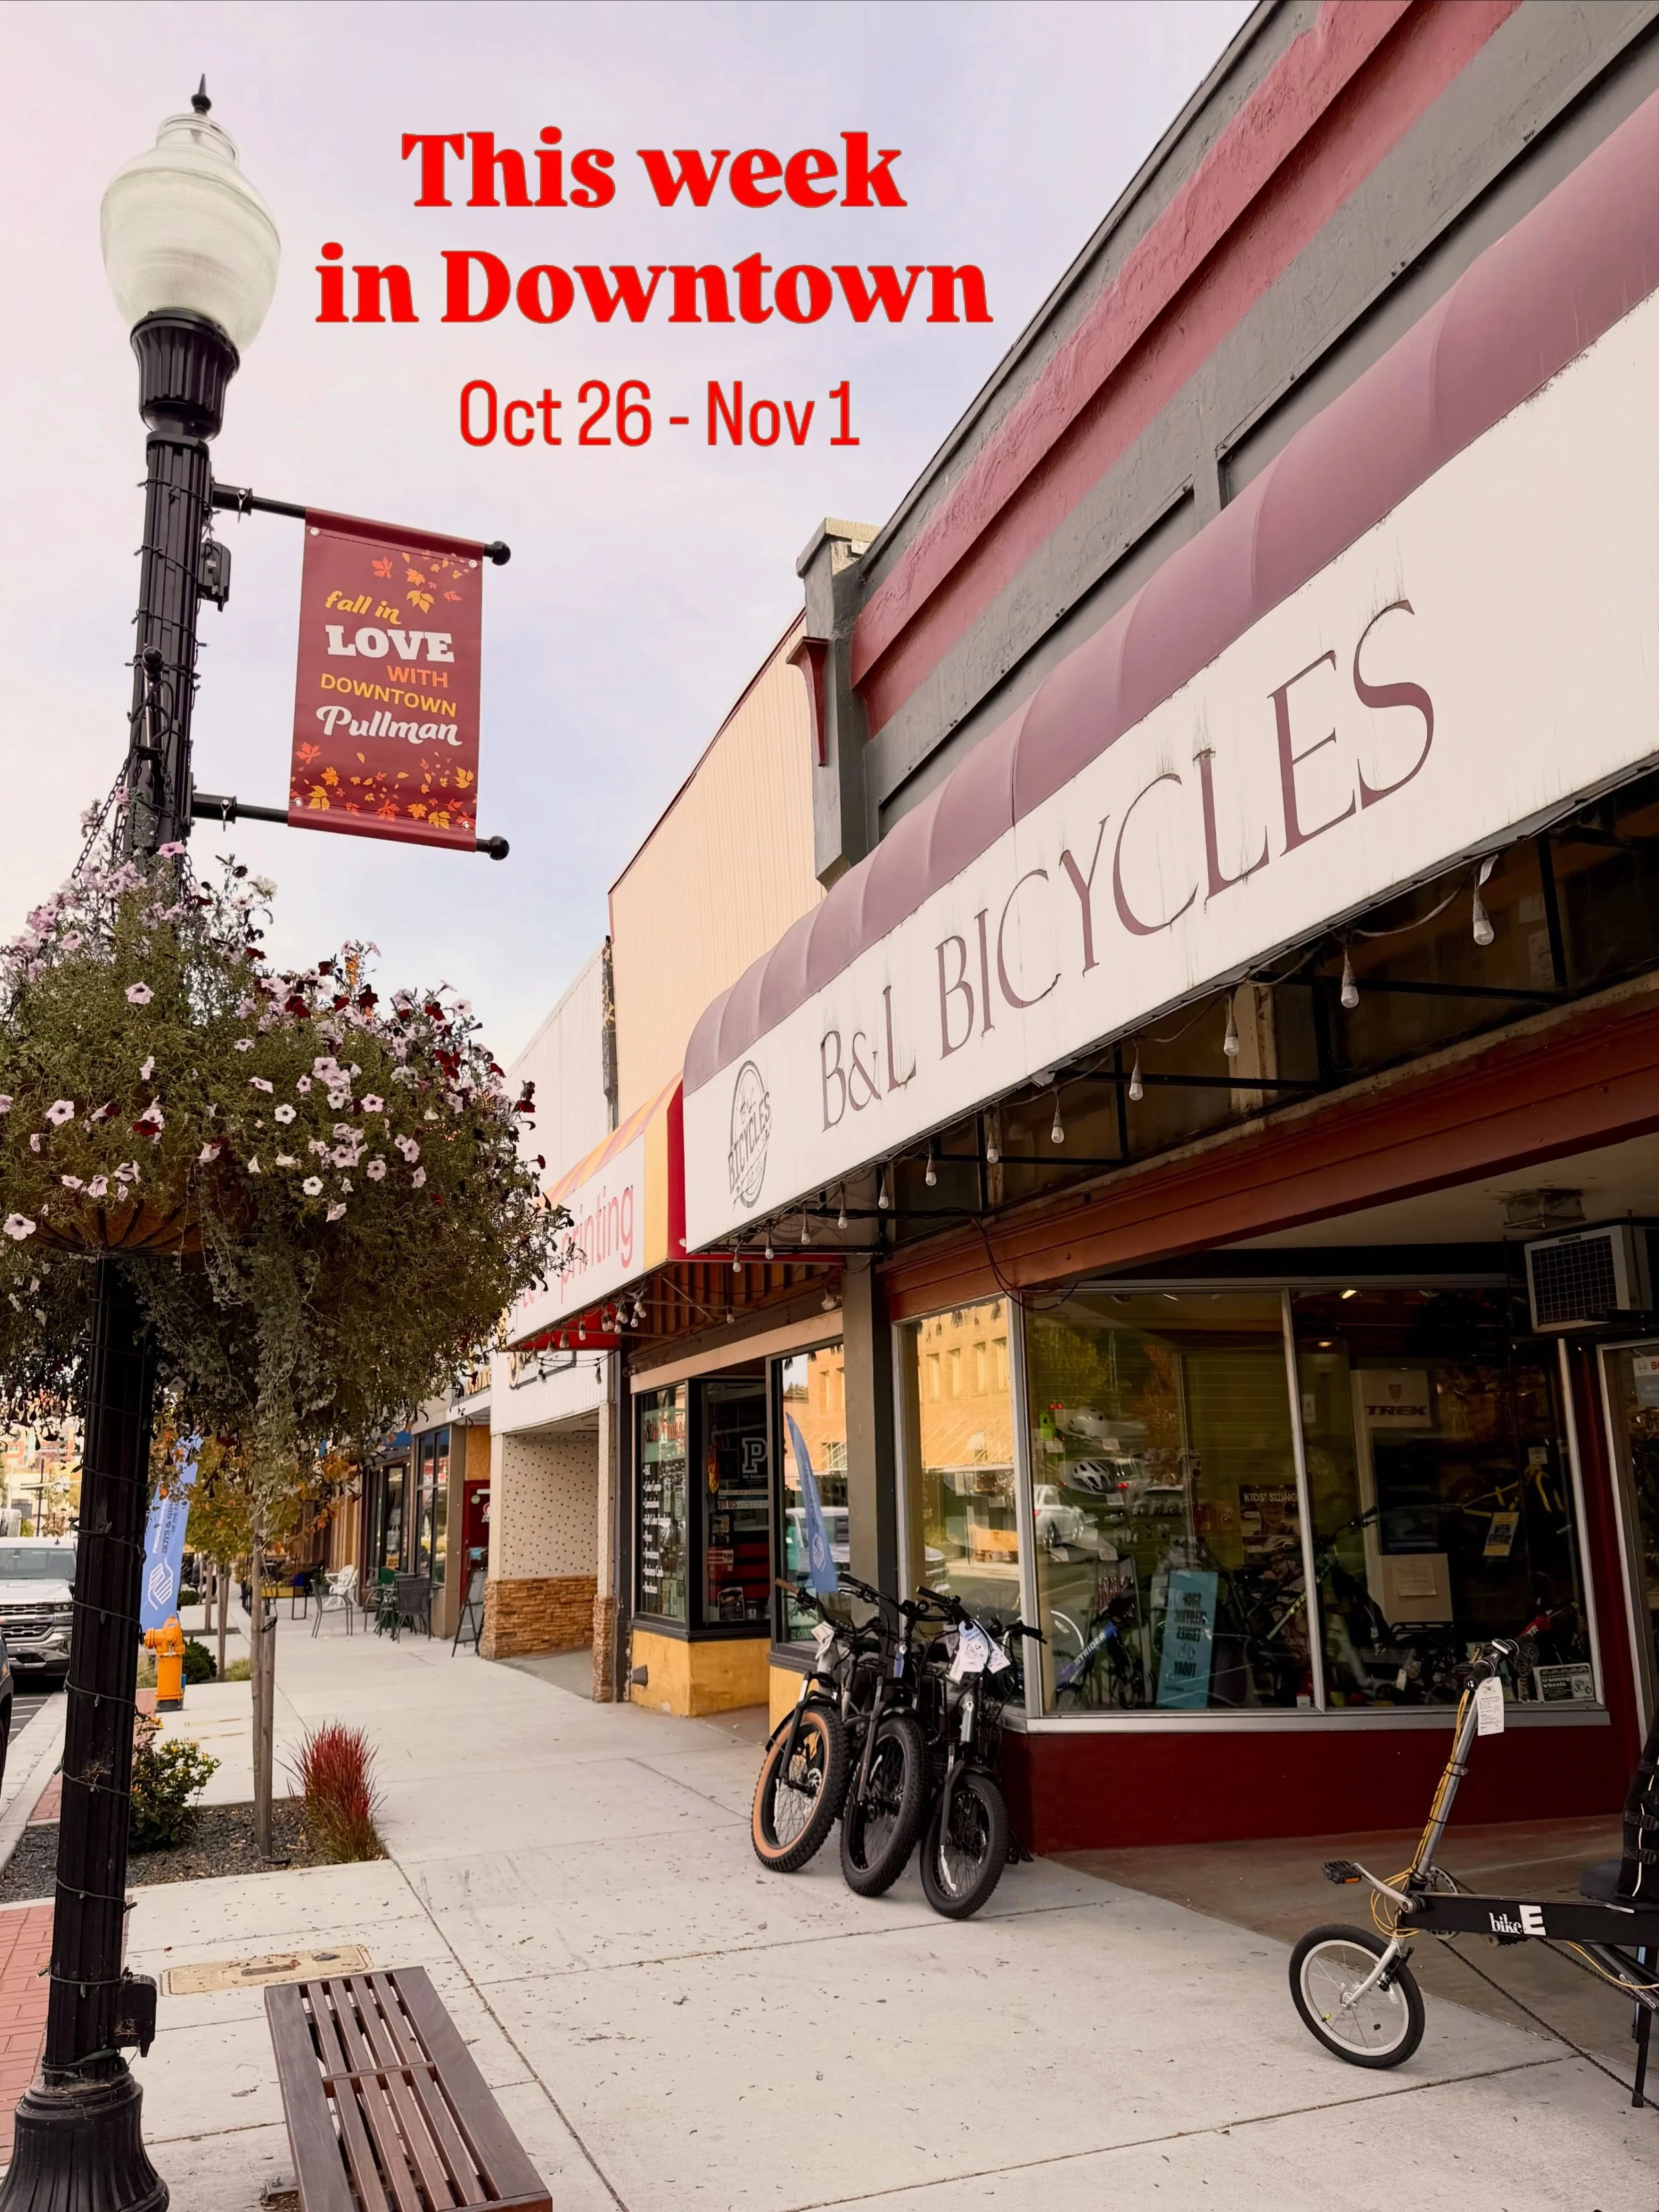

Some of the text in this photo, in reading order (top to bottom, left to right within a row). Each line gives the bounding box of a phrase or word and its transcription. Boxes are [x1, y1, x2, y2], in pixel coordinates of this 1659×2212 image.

[325, 590, 402, 625] fall in
[325, 624, 455, 662] LOVE
[386, 664, 449, 688] WITH
[321, 673, 457, 717] DOWNTOWN
[316, 705, 463, 747] Pullman
[819, 599, 1435, 1134] B&L BICYCLES
[727, 1091, 770, 1195] BICYCLES
[561, 1185, 634, 1304] printing
[1364, 1405, 1428, 1416] TREK
[742, 1437, 768, 1473] P
[1243, 1491, 1298, 1503] KIDS' SIZING
[1074, 1631, 1106, 1666] STRIDER
